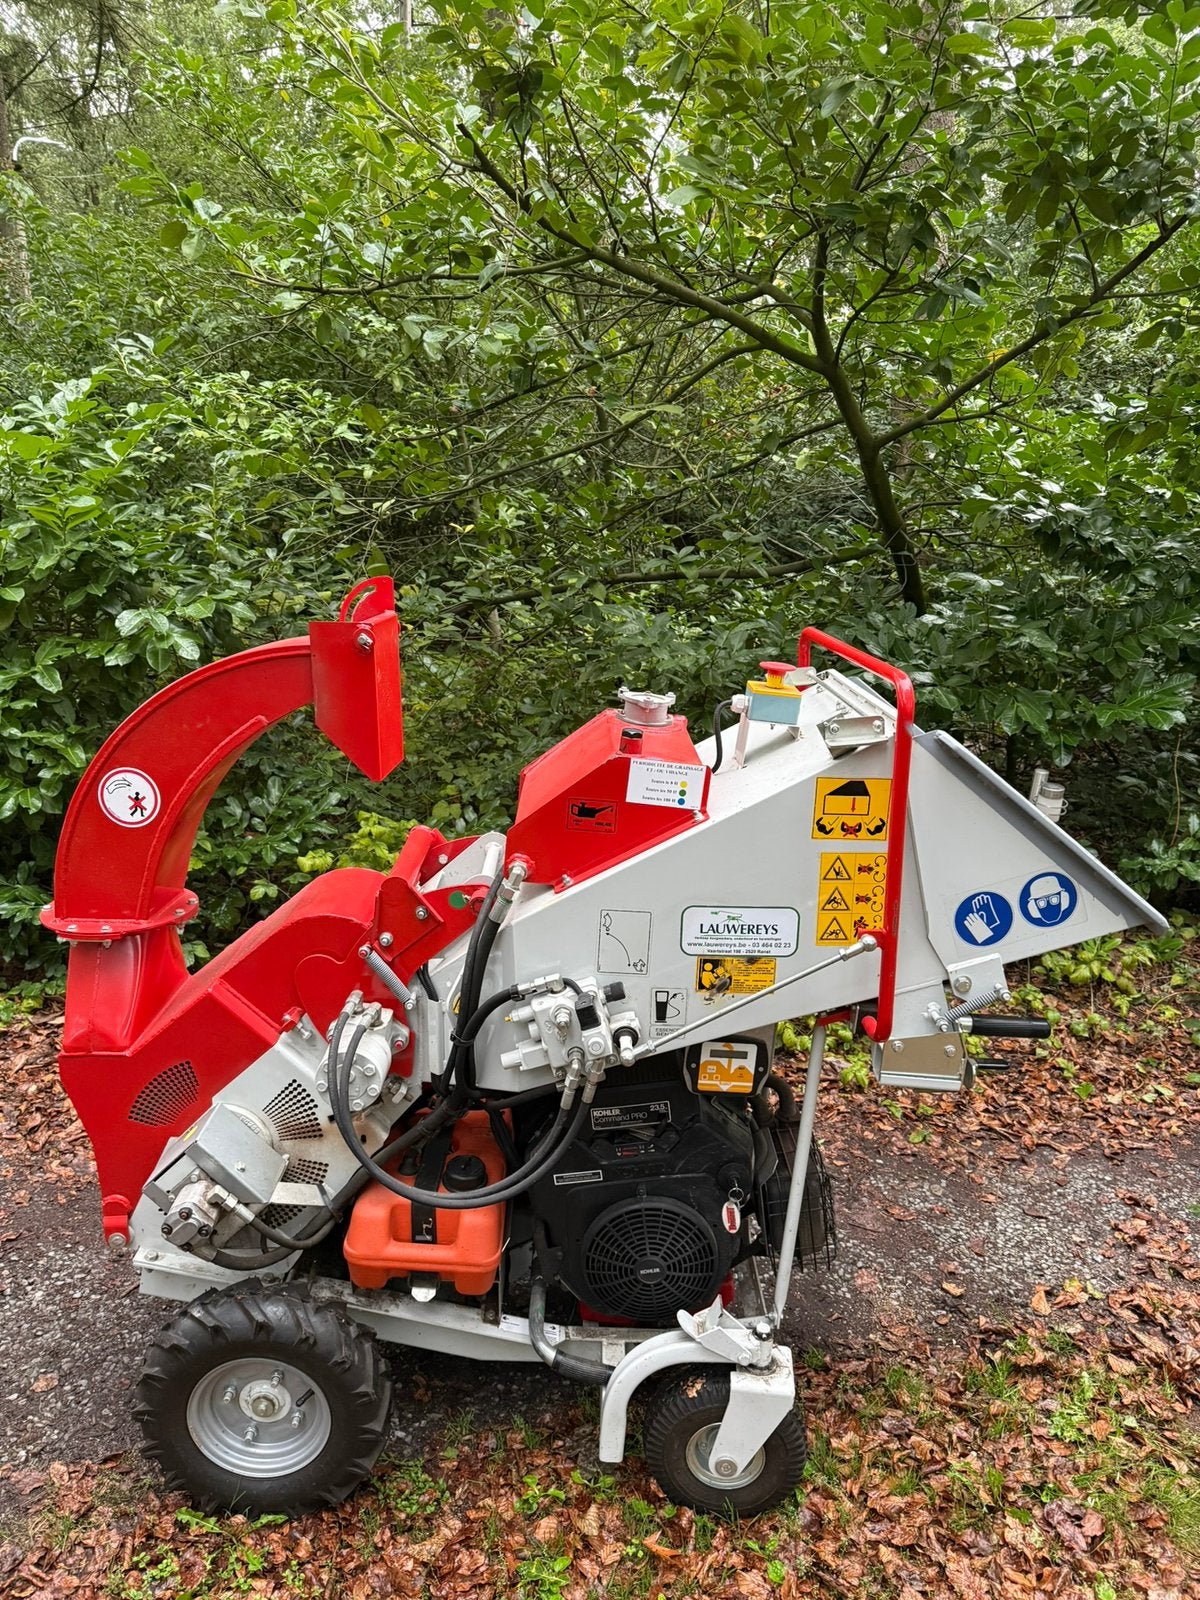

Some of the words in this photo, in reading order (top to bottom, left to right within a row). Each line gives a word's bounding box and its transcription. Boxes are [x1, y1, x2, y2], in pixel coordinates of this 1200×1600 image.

[700, 923, 778, 935] LAUWEREYS
[687, 941, 747, 949] www.lauwereys.be
[593, 1108, 621, 1117] KOHLER
[593, 1114, 630, 1123] Command
[630, 1111, 648, 1119] PRO
[640, 1267, 660, 1275] KOHLER
